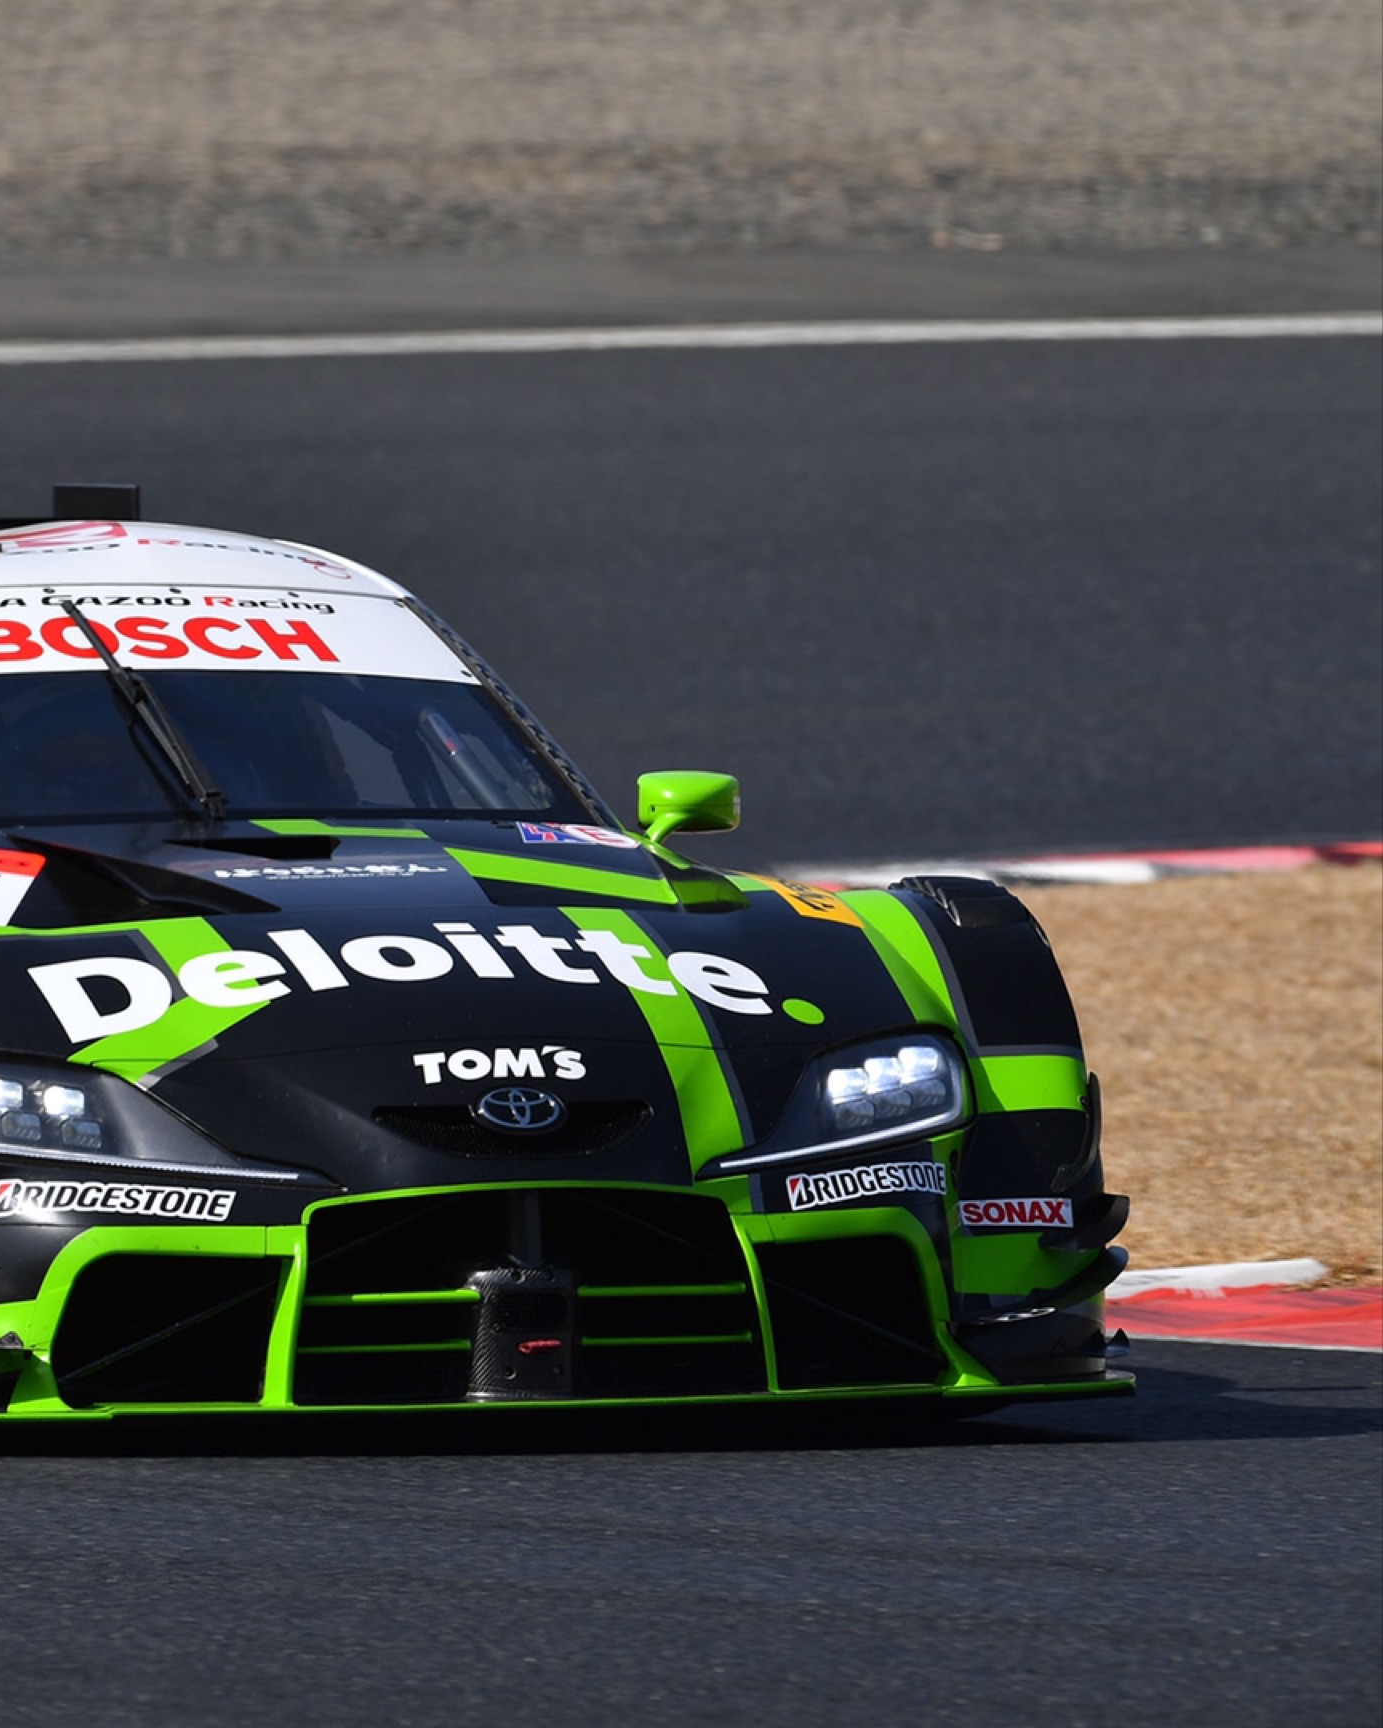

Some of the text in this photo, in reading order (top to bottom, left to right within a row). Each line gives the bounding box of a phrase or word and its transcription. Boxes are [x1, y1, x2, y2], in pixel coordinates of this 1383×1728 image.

[41, 595, 191, 608] GAZOO
[204, 596, 335, 615] Racing
[413, 1045, 587, 1085] TOM'S
[788, 1163, 946, 1209] BRIDGESTONE
[963, 1200, 1067, 1225] SONAX
